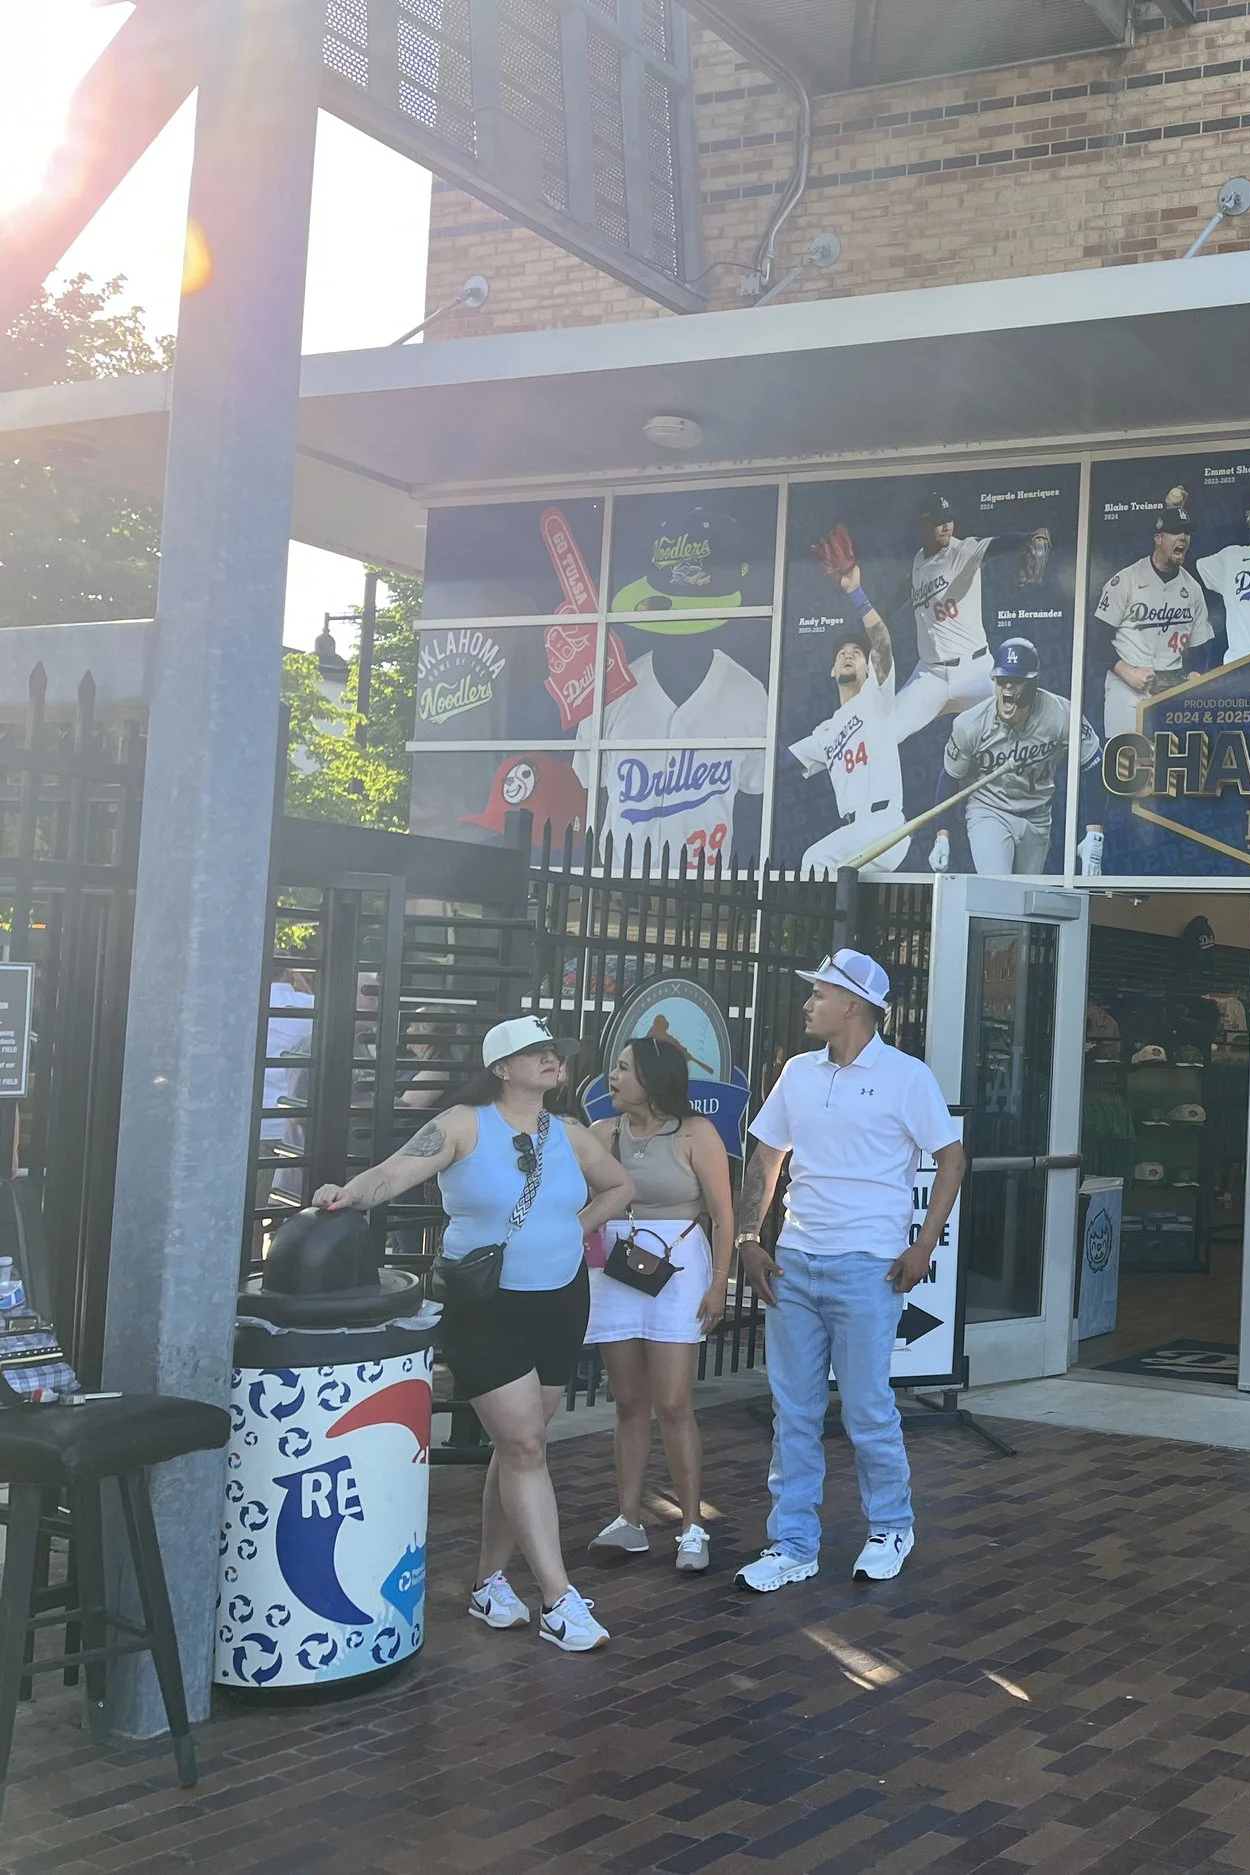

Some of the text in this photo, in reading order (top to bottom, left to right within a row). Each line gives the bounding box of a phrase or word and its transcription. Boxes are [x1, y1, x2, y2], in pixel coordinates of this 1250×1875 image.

[1204, 467, 1234, 477] Emmet
[980, 489, 1060, 503] Edgardo Henriquez
[1104, 502, 1163, 512] Blake Treinen
[652, 533, 711, 569] Noodlers
[552, 531, 588, 606] GO TULSA
[799, 616, 844, 627] Andy Pages
[933, 599, 959, 622] 60
[1126, 602, 1194, 633] Dodgers
[1006, 648, 1019, 664] LA
[419, 674, 493, 725] Noodlers
[1184, 699, 1217, 709] PROUD
[1166, 711, 1200, 724] 2024
[1203, 711, 1214, 723] &
[1217, 710, 1250, 723] 2025
[844, 741, 868, 774] 84
[975, 740, 1057, 777] Dodgers
[617, 749, 733, 825] Drillers
[686, 823, 728, 870] 39
[689, 1098, 719, 1114] RLD
